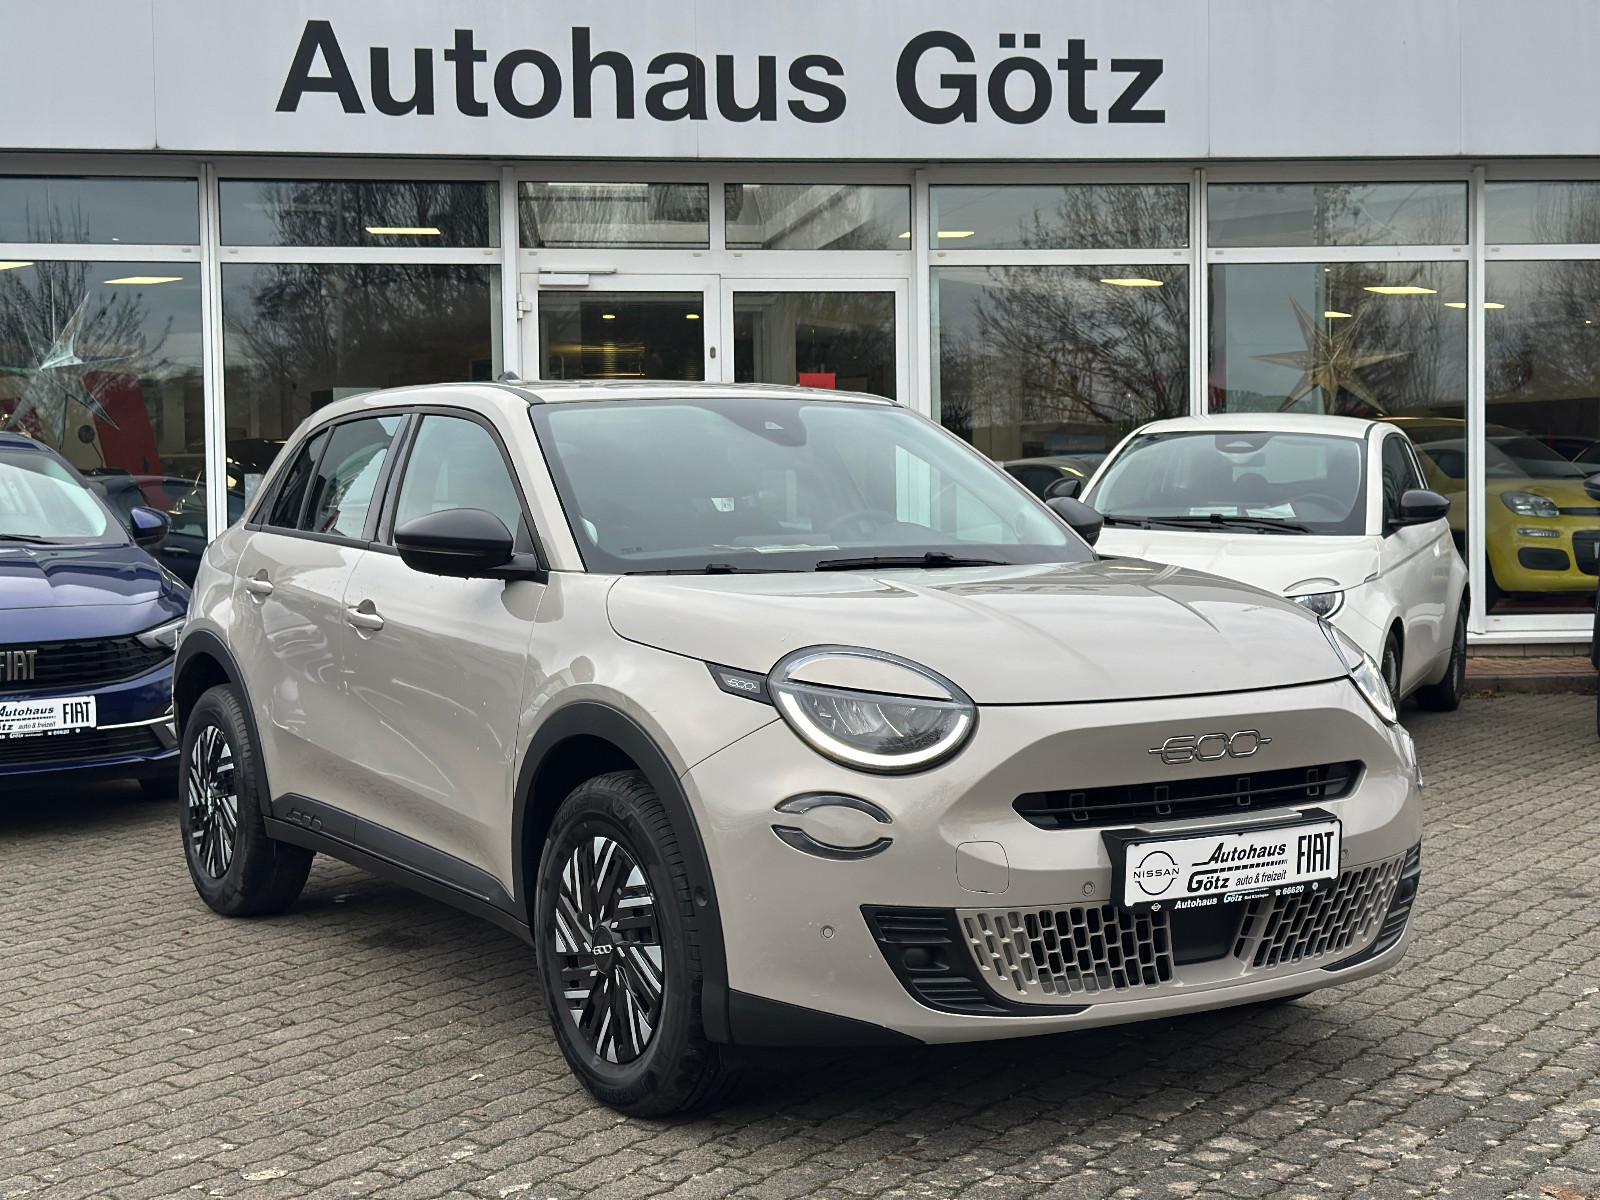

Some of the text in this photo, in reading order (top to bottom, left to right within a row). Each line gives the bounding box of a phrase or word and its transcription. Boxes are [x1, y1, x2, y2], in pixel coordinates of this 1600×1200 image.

[275, 20, 1166, 124] Autohaus Götz
[0, 649, 37, 681] FIAT
[728, 678, 756, 691] 600
[63, 701, 91, 724] FIAT
[1159, 729, 1262, 765] 600
[1191, 842, 1287, 867] Autohaus
[1297, 831, 1334, 875] FIAT
[1133, 867, 1180, 879] NISSAN
[1187, 870, 1230, 893] Götz
[1235, 869, 1287, 887] auto & freizeit
[1174, 897, 1218, 909] Autohaus
[1223, 891, 1243, 903] Götz
